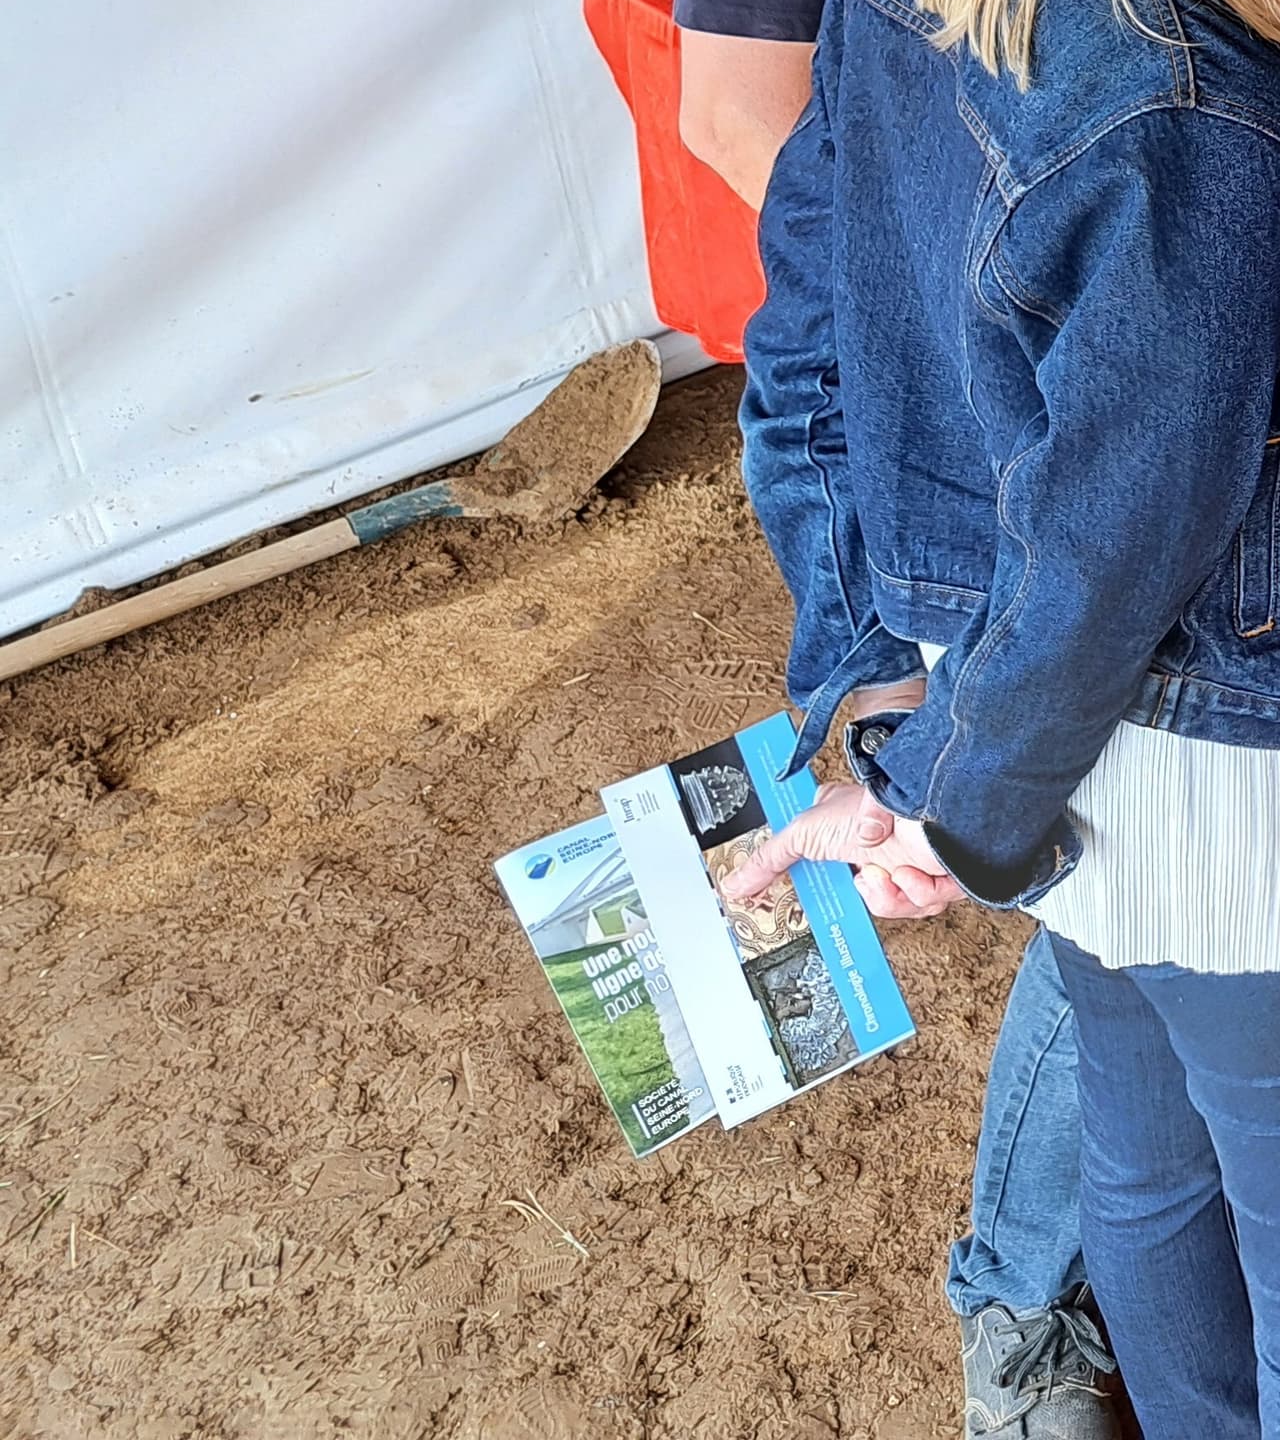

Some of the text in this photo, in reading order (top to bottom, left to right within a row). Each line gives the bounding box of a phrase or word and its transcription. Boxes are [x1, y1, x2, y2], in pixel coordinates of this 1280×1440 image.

[582, 946, 622, 978] Une
[592, 961, 643, 1000] ligne
[603, 985, 643, 1024] pour
[848, 966, 880, 1034] Chronologie
[642, 1085, 689, 1118] DU CANAL
[651, 1107, 691, 1135] EUROPE
